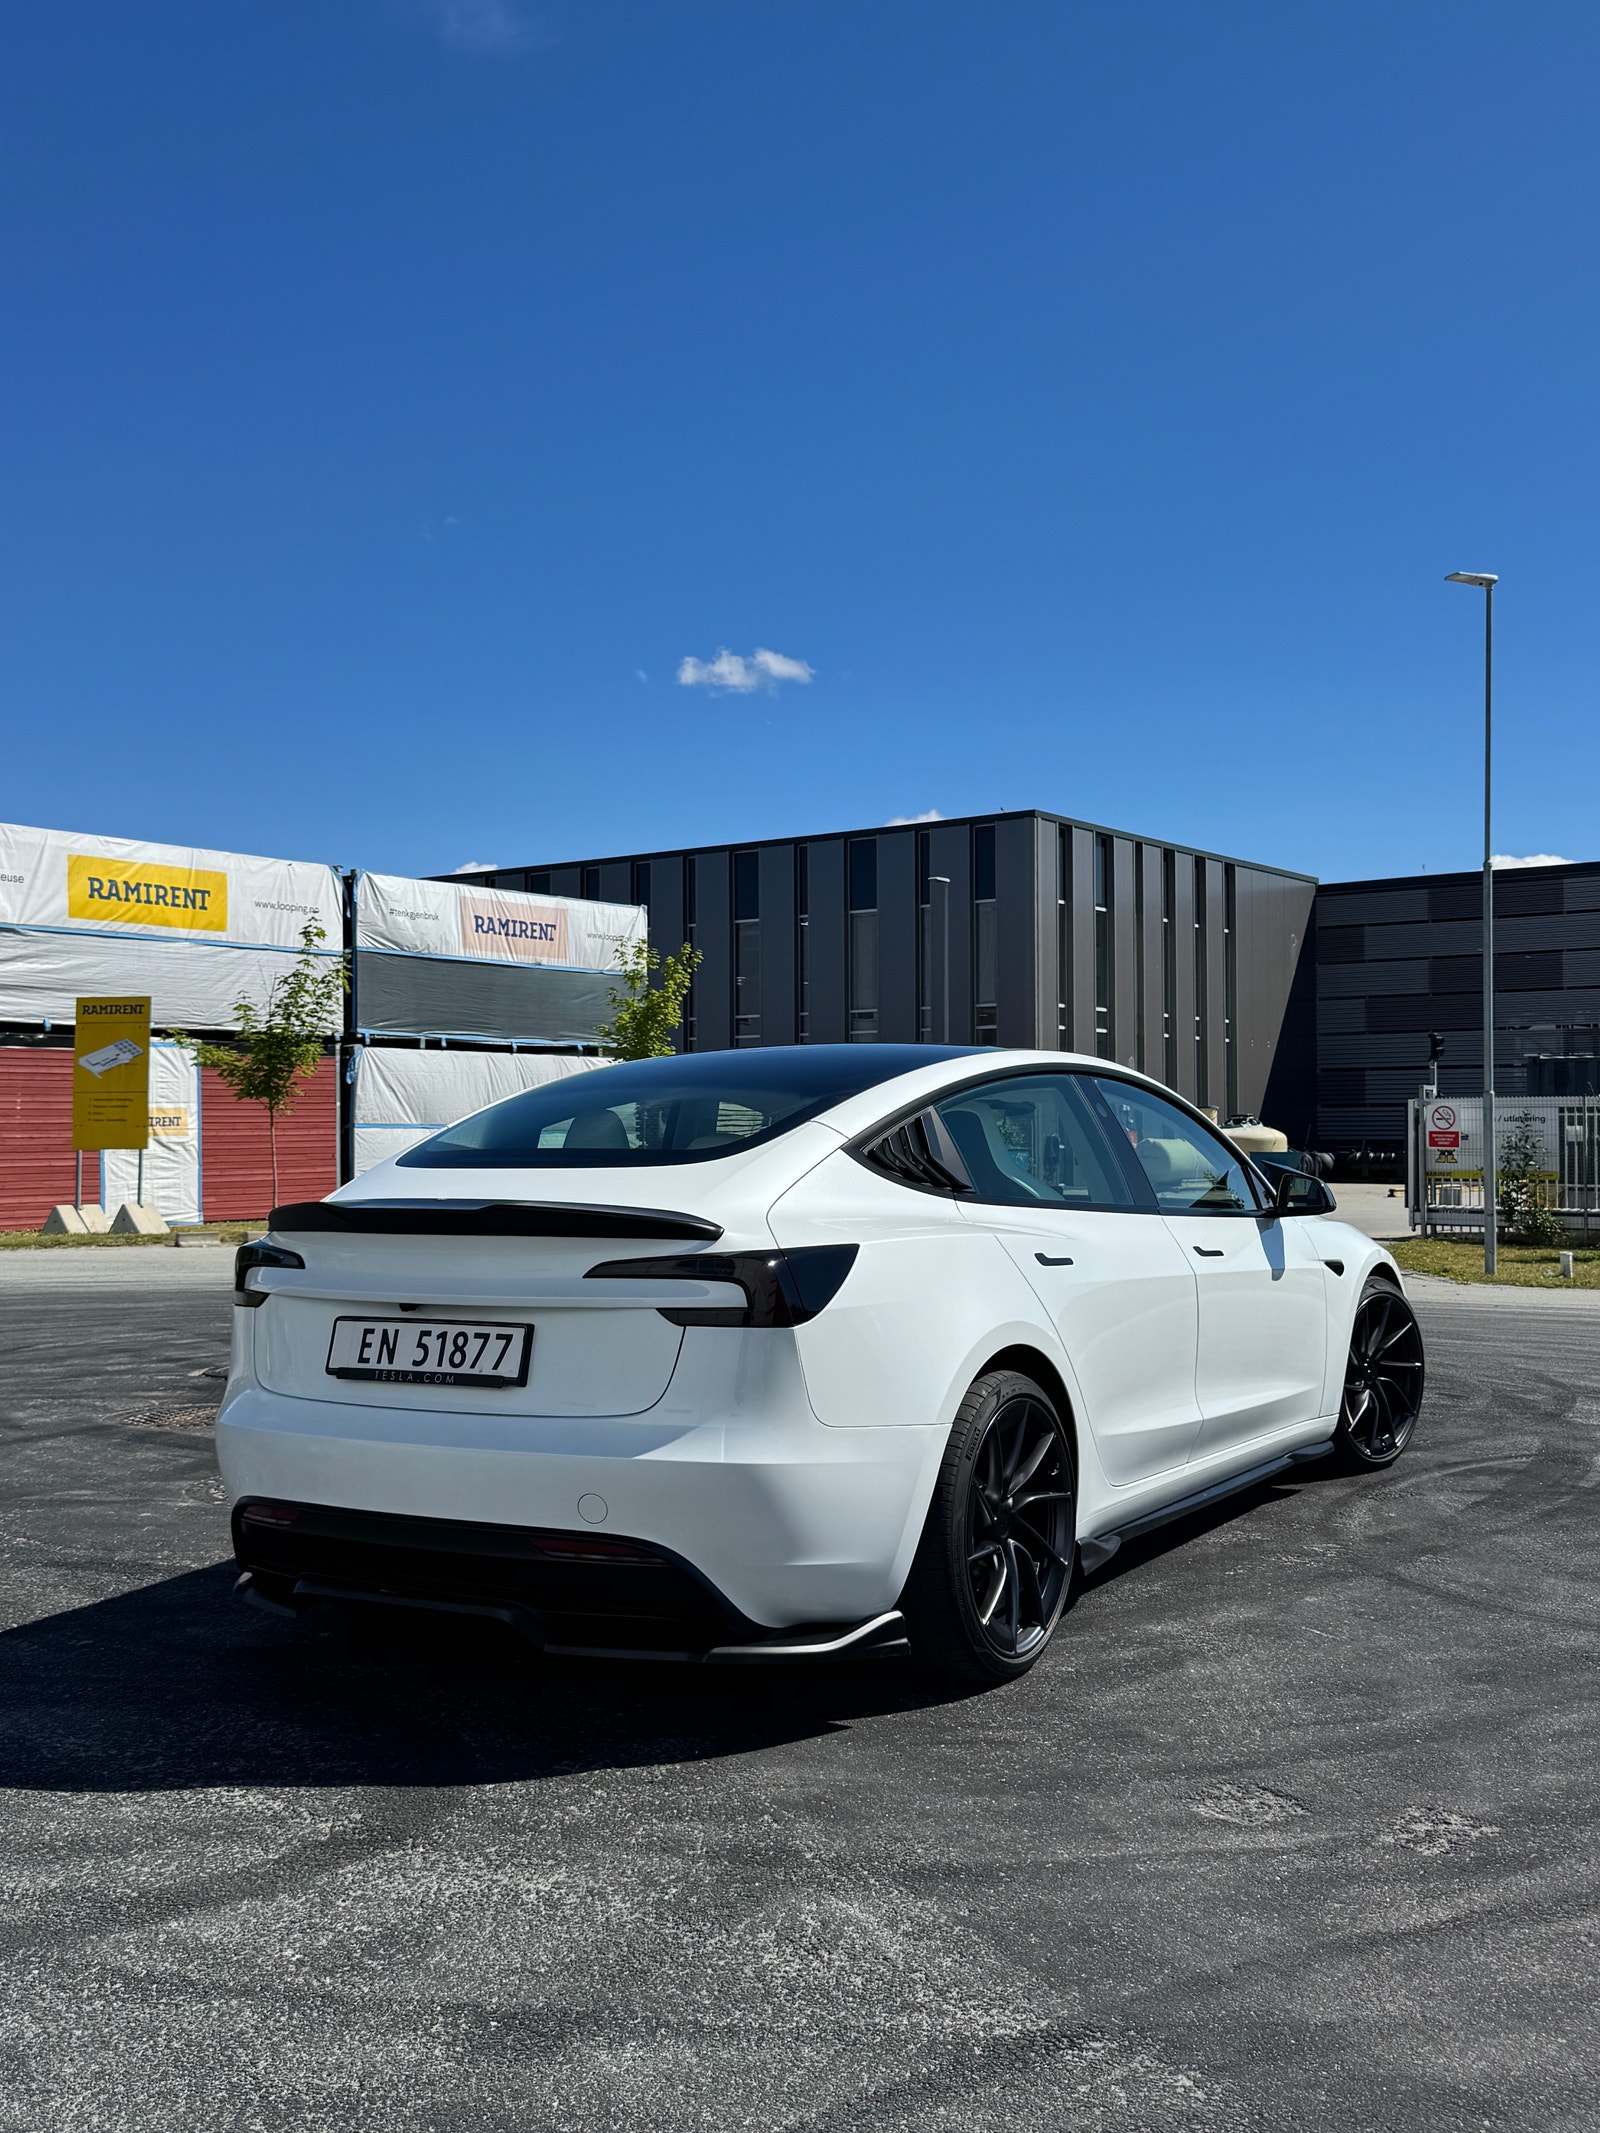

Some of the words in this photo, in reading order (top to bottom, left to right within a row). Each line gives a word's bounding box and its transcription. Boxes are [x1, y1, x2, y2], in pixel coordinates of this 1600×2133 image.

[88, 876, 211, 911] RAMIRENT
[474, 914, 557, 942] RAMIRENT
[82, 1004, 145, 1015] RAMIRENT
[357, 1328, 400, 1365] EN
[411, 1330, 514, 1371] 51877
[374, 1371, 455, 1384] TESLA.COM
